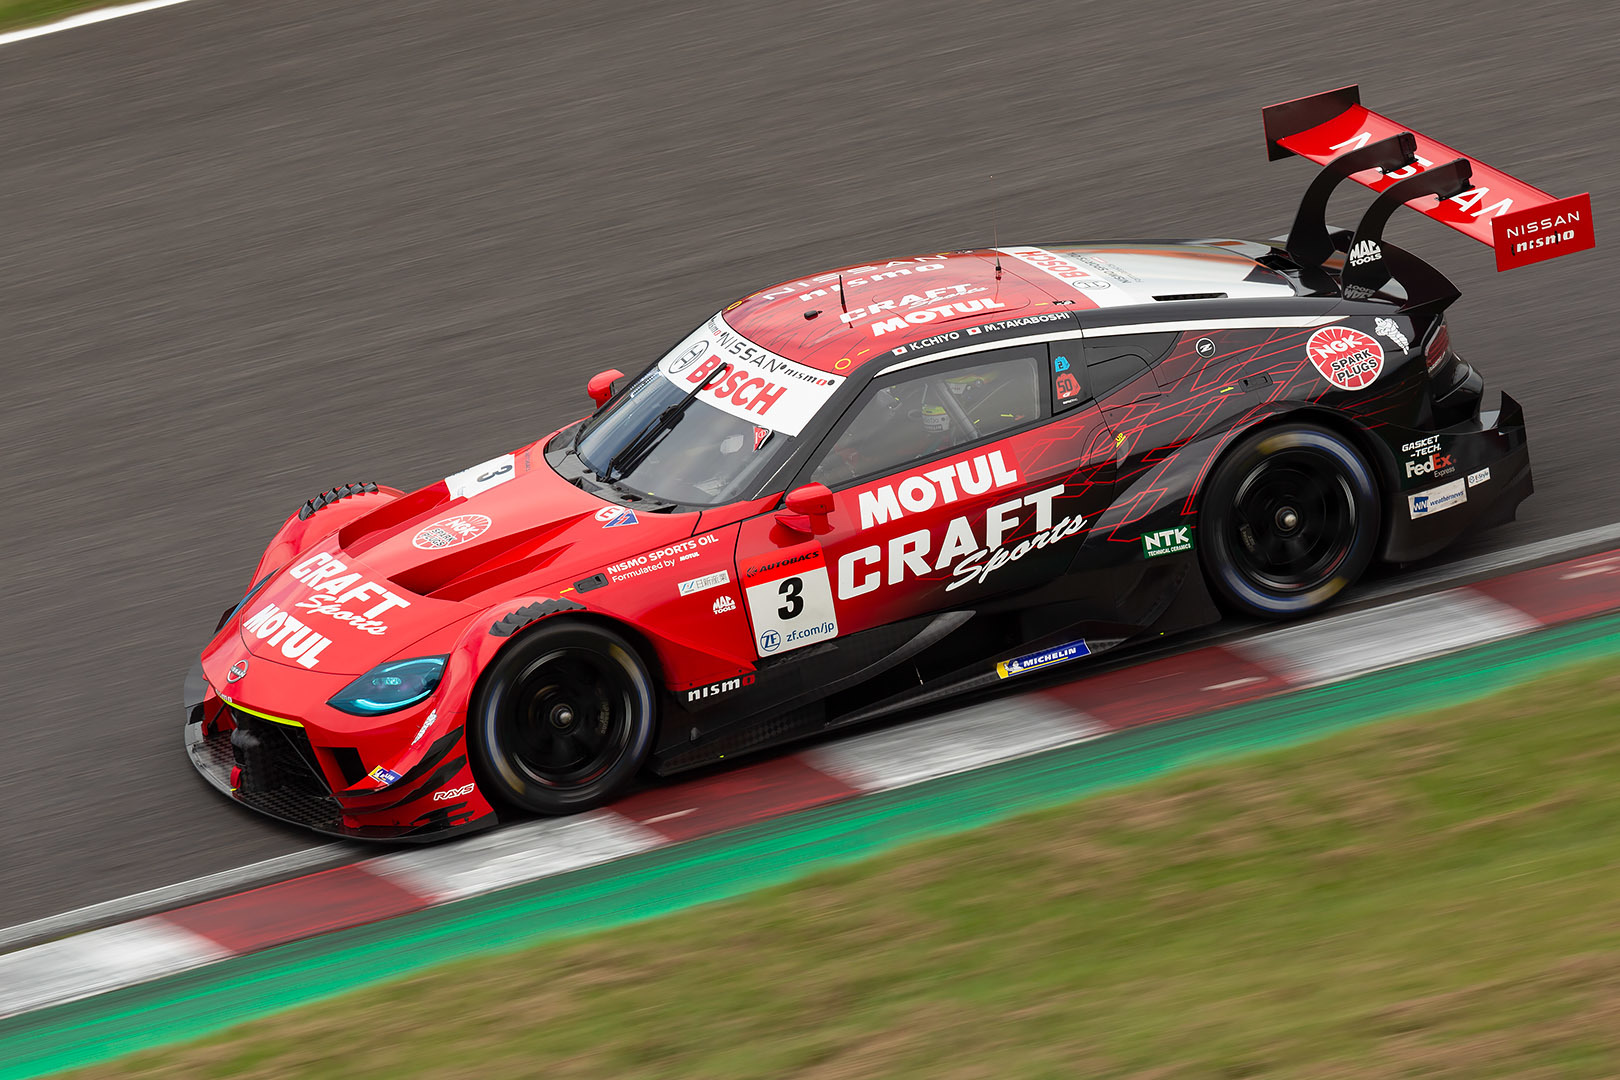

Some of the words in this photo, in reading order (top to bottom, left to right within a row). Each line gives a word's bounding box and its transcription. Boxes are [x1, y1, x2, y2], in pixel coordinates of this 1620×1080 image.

[1506, 210, 1580, 239] NISSAN
[1349, 239, 1382, 261] MAC
[1516, 229, 1575, 253] nismo
[1013, 250, 1090, 279] BOSCH
[1350, 252, 1383, 267] TOOLS
[762, 254, 949, 301] NISSAN
[798, 263, 945, 302] nismo
[839, 283, 972, 324] CRAFT
[871, 297, 1006, 337] MOTUL
[984, 312, 1070, 332] M.TAKABOSHI
[909, 332, 960, 351] K.CHIYO
[1314, 334, 1363, 359] NGK
[717, 332, 782, 373] NISSAN
[784, 368, 827, 386] nismo
[1331, 349, 1372, 371] SPARK
[1336, 359, 1378, 382] PLUGS
[686, 354, 788, 416] BOSCH
[1057, 378, 1073, 394] 50
[1401, 434, 1440, 452] GASKET
[476, 464, 513, 483] 3
[1405, 453, 1453, 478] FedEx
[858, 450, 1018, 531] MOTUL
[445, 519, 480, 536] NGK
[1144, 526, 1190, 551] NTK
[606, 556, 648, 575] NISMO
[648, 540, 697, 562] SPORTS
[697, 534, 719, 546] OIL
[837, 484, 1065, 601] CRAFT
[945, 513, 1088, 592] Sports
[611, 562, 664, 583] Formulated
[663, 559, 675, 567] by
[679, 552, 700, 562] MOTUL
[759, 550, 820, 573] AUTOBACS
[289, 551, 412, 620] CRAFT
[712, 595, 736, 611] MAC
[713, 604, 737, 615] TOOLS
[777, 576, 804, 621] 3
[294, 594, 388, 635] Sports
[242, 602, 333, 670] MOTUL
[786, 621, 835, 642] zf.com/jp
[1023, 647, 1077, 668] MICHELIN
[687, 674, 756, 702] nismo
[433, 782, 475, 801] RAYS
